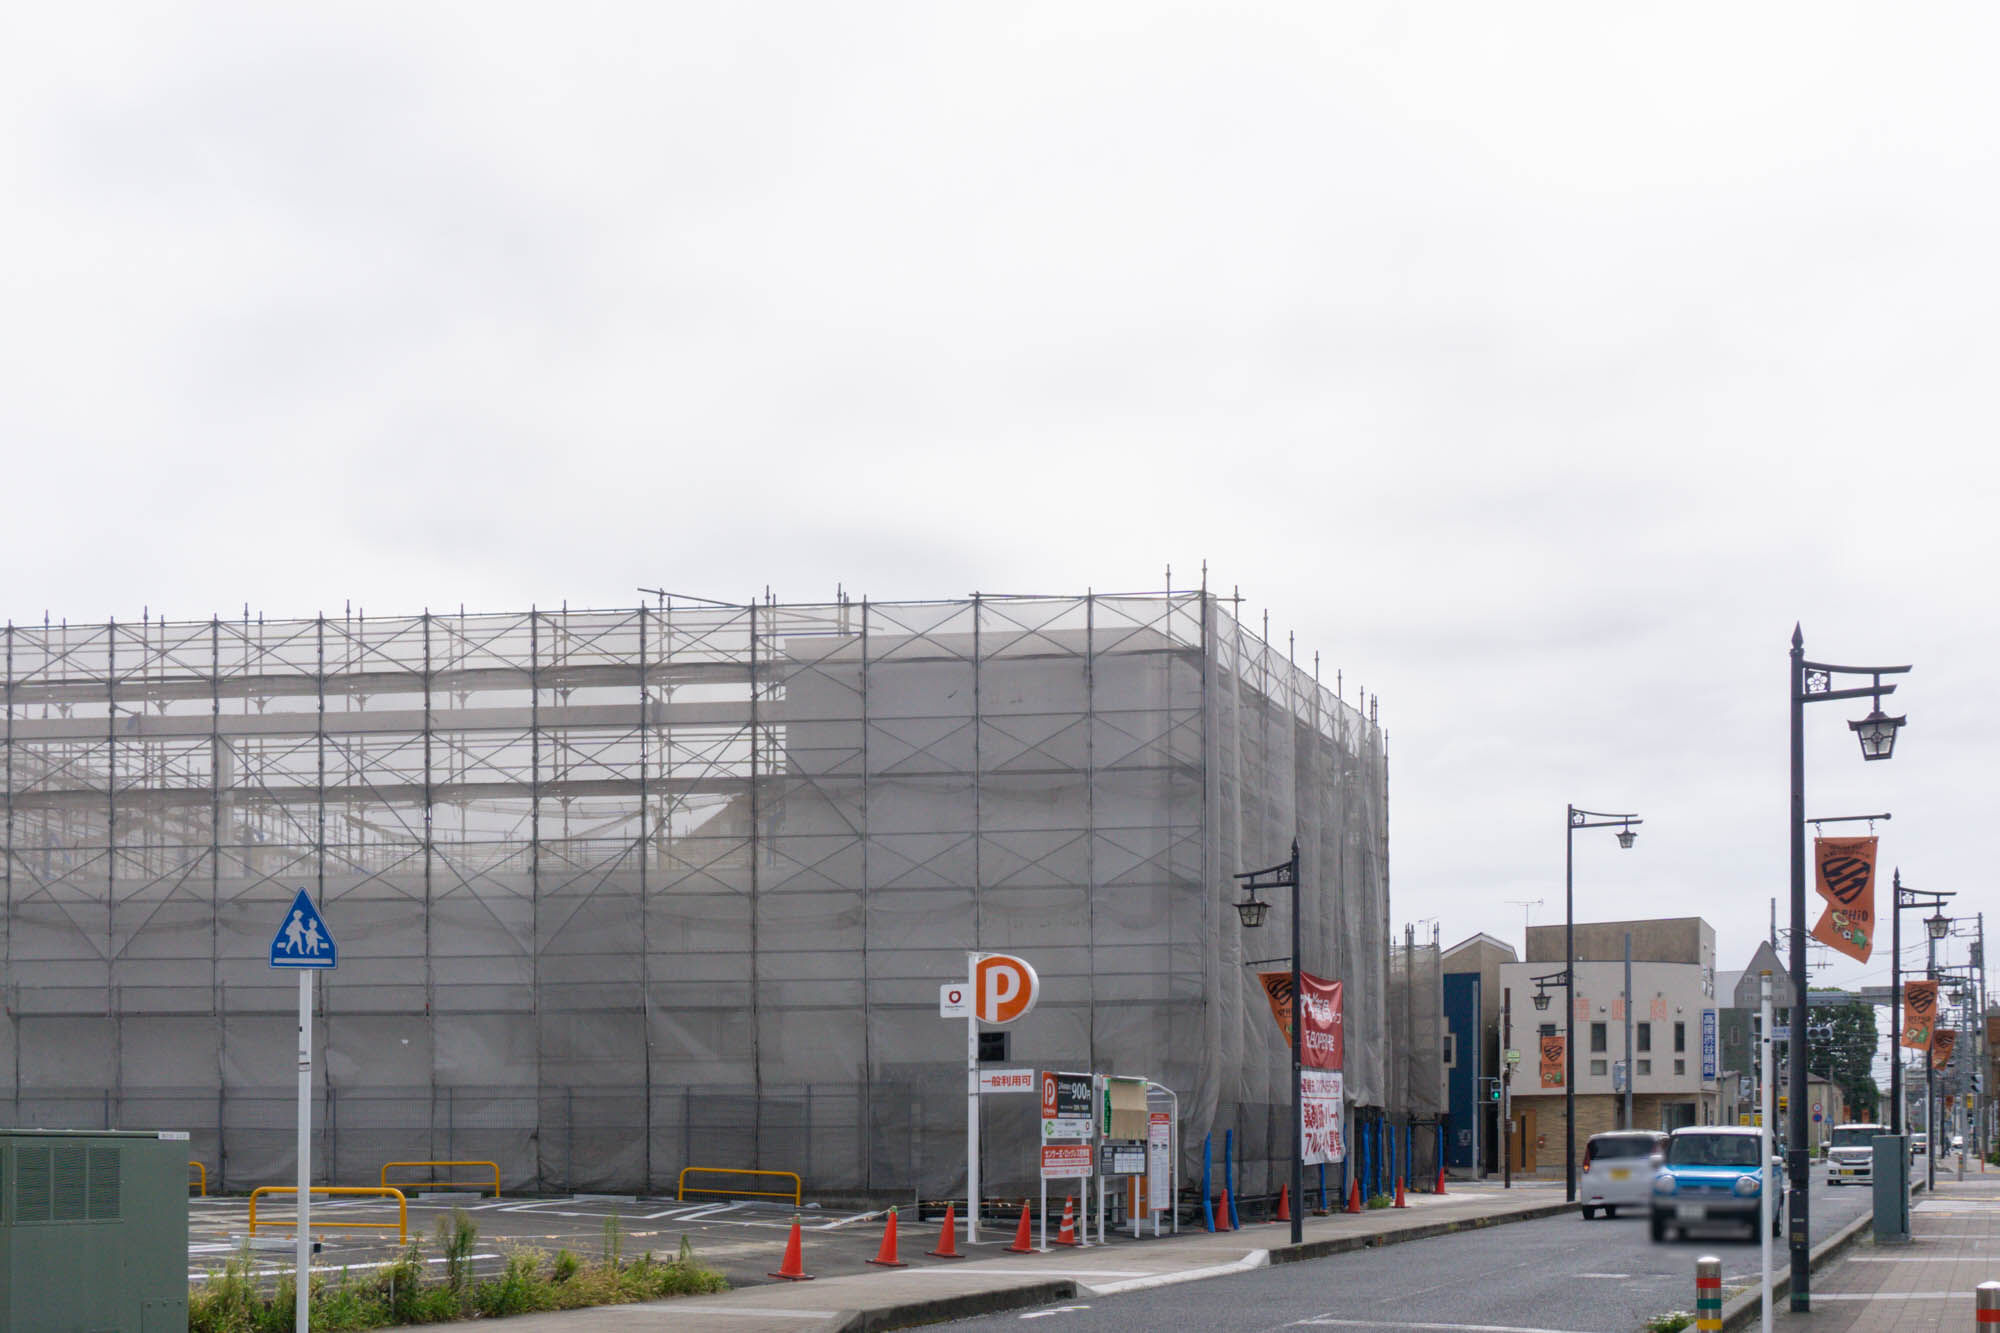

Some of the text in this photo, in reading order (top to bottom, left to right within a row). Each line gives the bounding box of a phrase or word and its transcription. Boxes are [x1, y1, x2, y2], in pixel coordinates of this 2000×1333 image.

[985, 965, 1021, 1022] P
[981, 1074, 1032, 1088] 一般利用可
